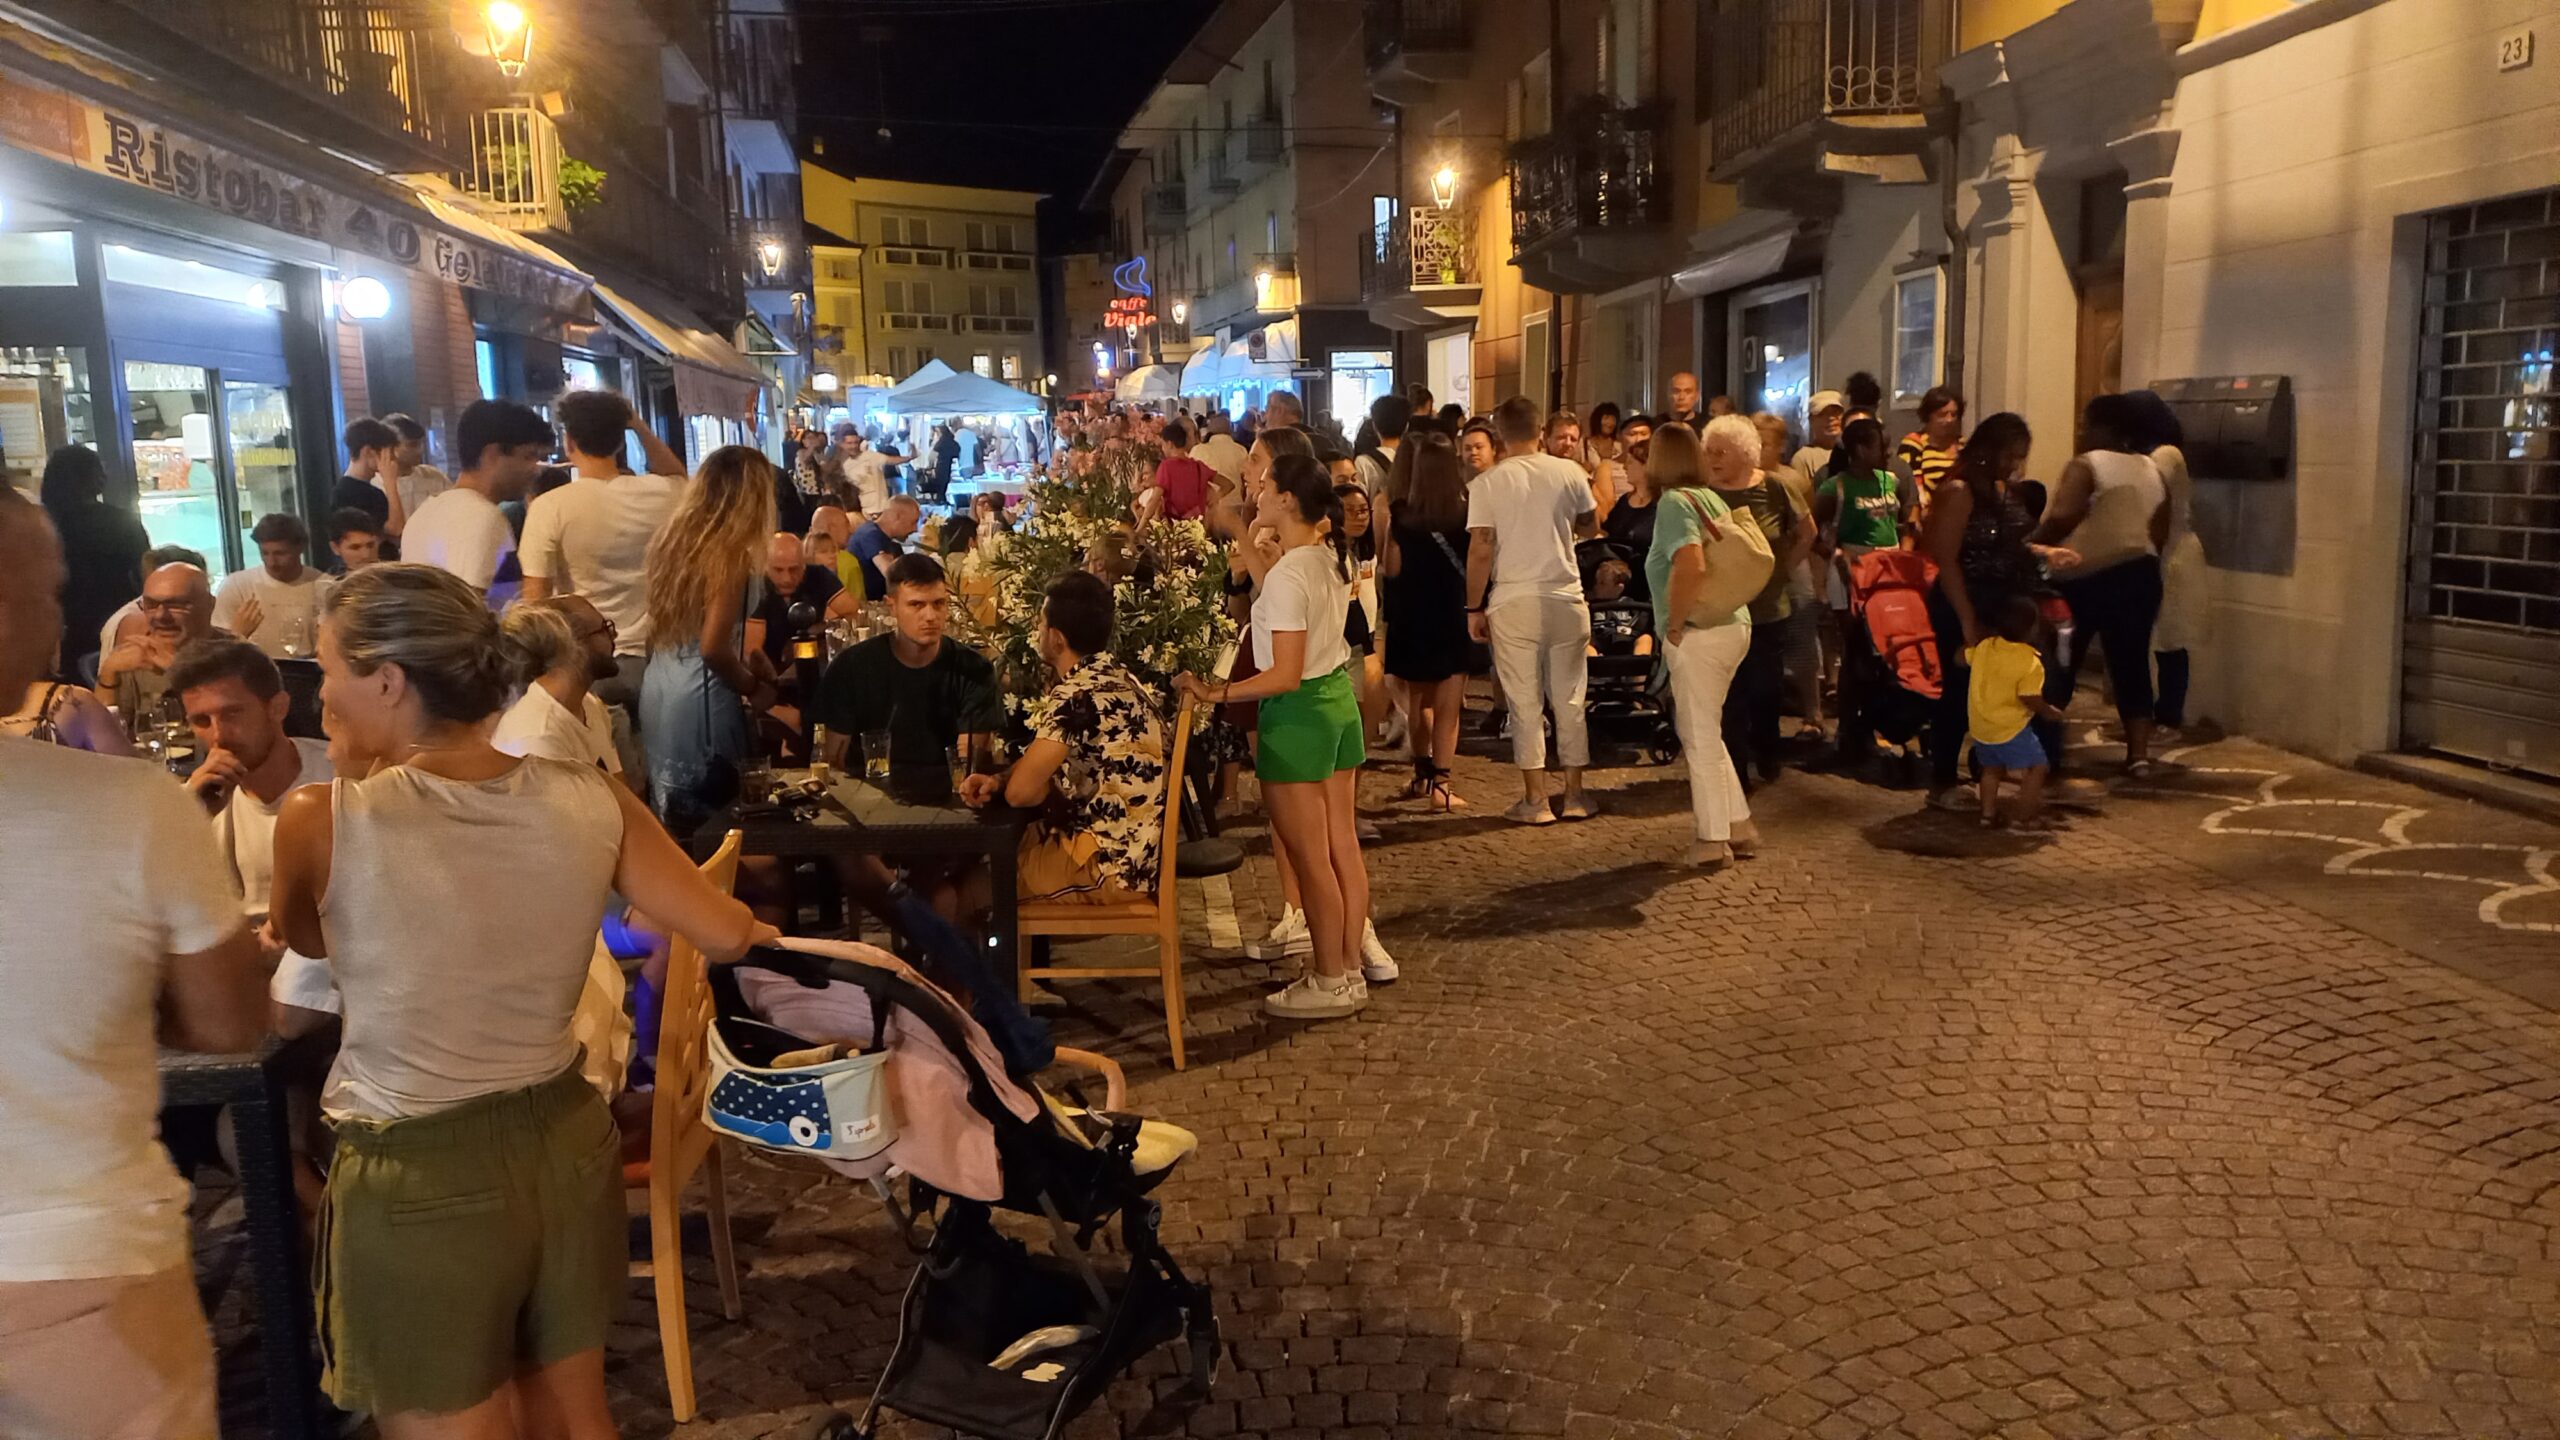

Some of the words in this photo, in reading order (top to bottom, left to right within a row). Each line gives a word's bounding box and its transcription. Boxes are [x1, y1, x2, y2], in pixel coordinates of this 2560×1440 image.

[2503, 37, 2523, 64] 23
[104, 113, 326, 236] Ristobar
[345, 206, 420, 265] 40
